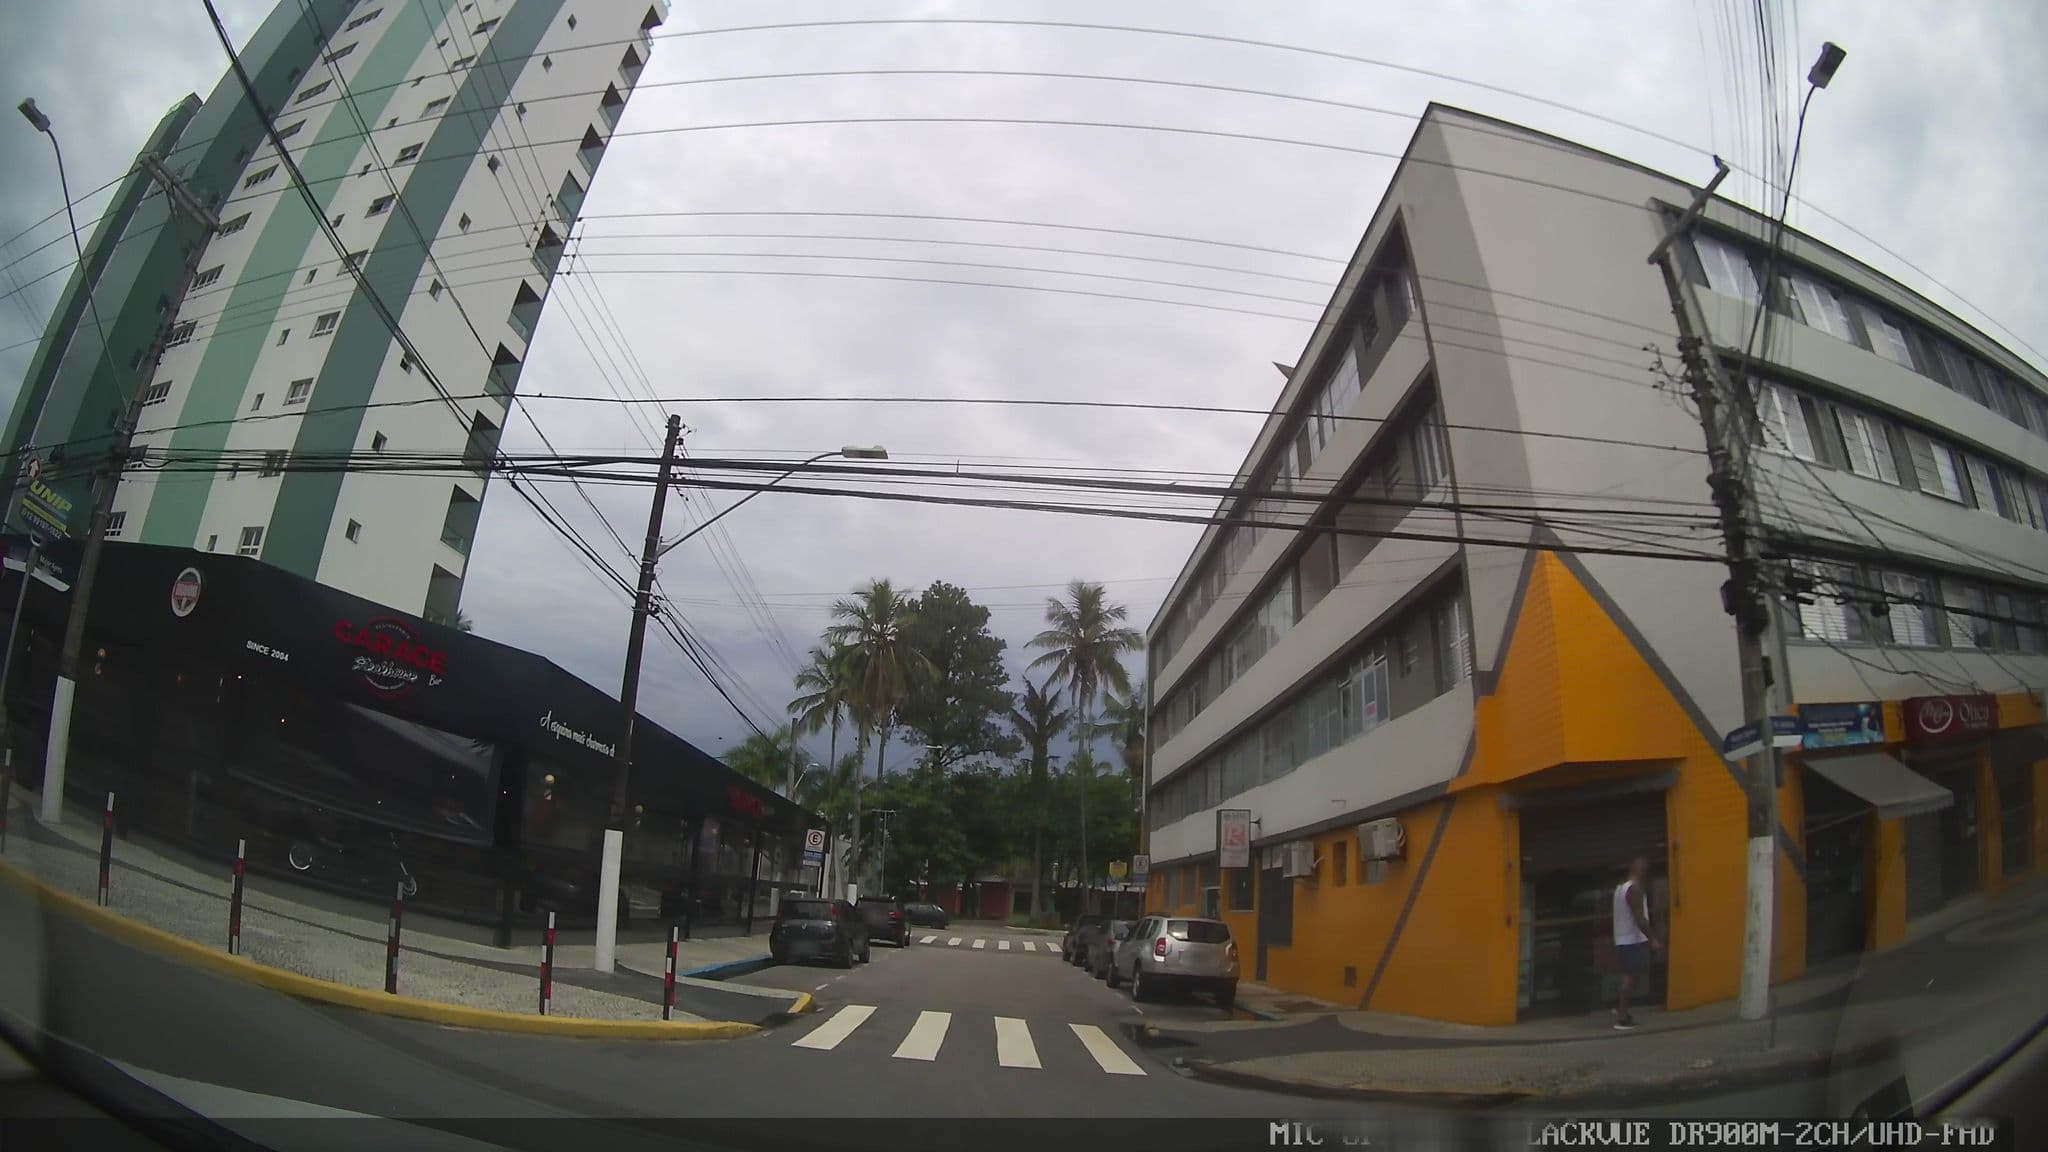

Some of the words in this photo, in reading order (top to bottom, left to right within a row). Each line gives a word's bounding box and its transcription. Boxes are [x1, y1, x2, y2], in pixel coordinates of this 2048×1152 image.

[30, 480, 72, 512] UNIP
[246, 640, 270, 655] SINCE
[271, 648, 289, 662] 2004
